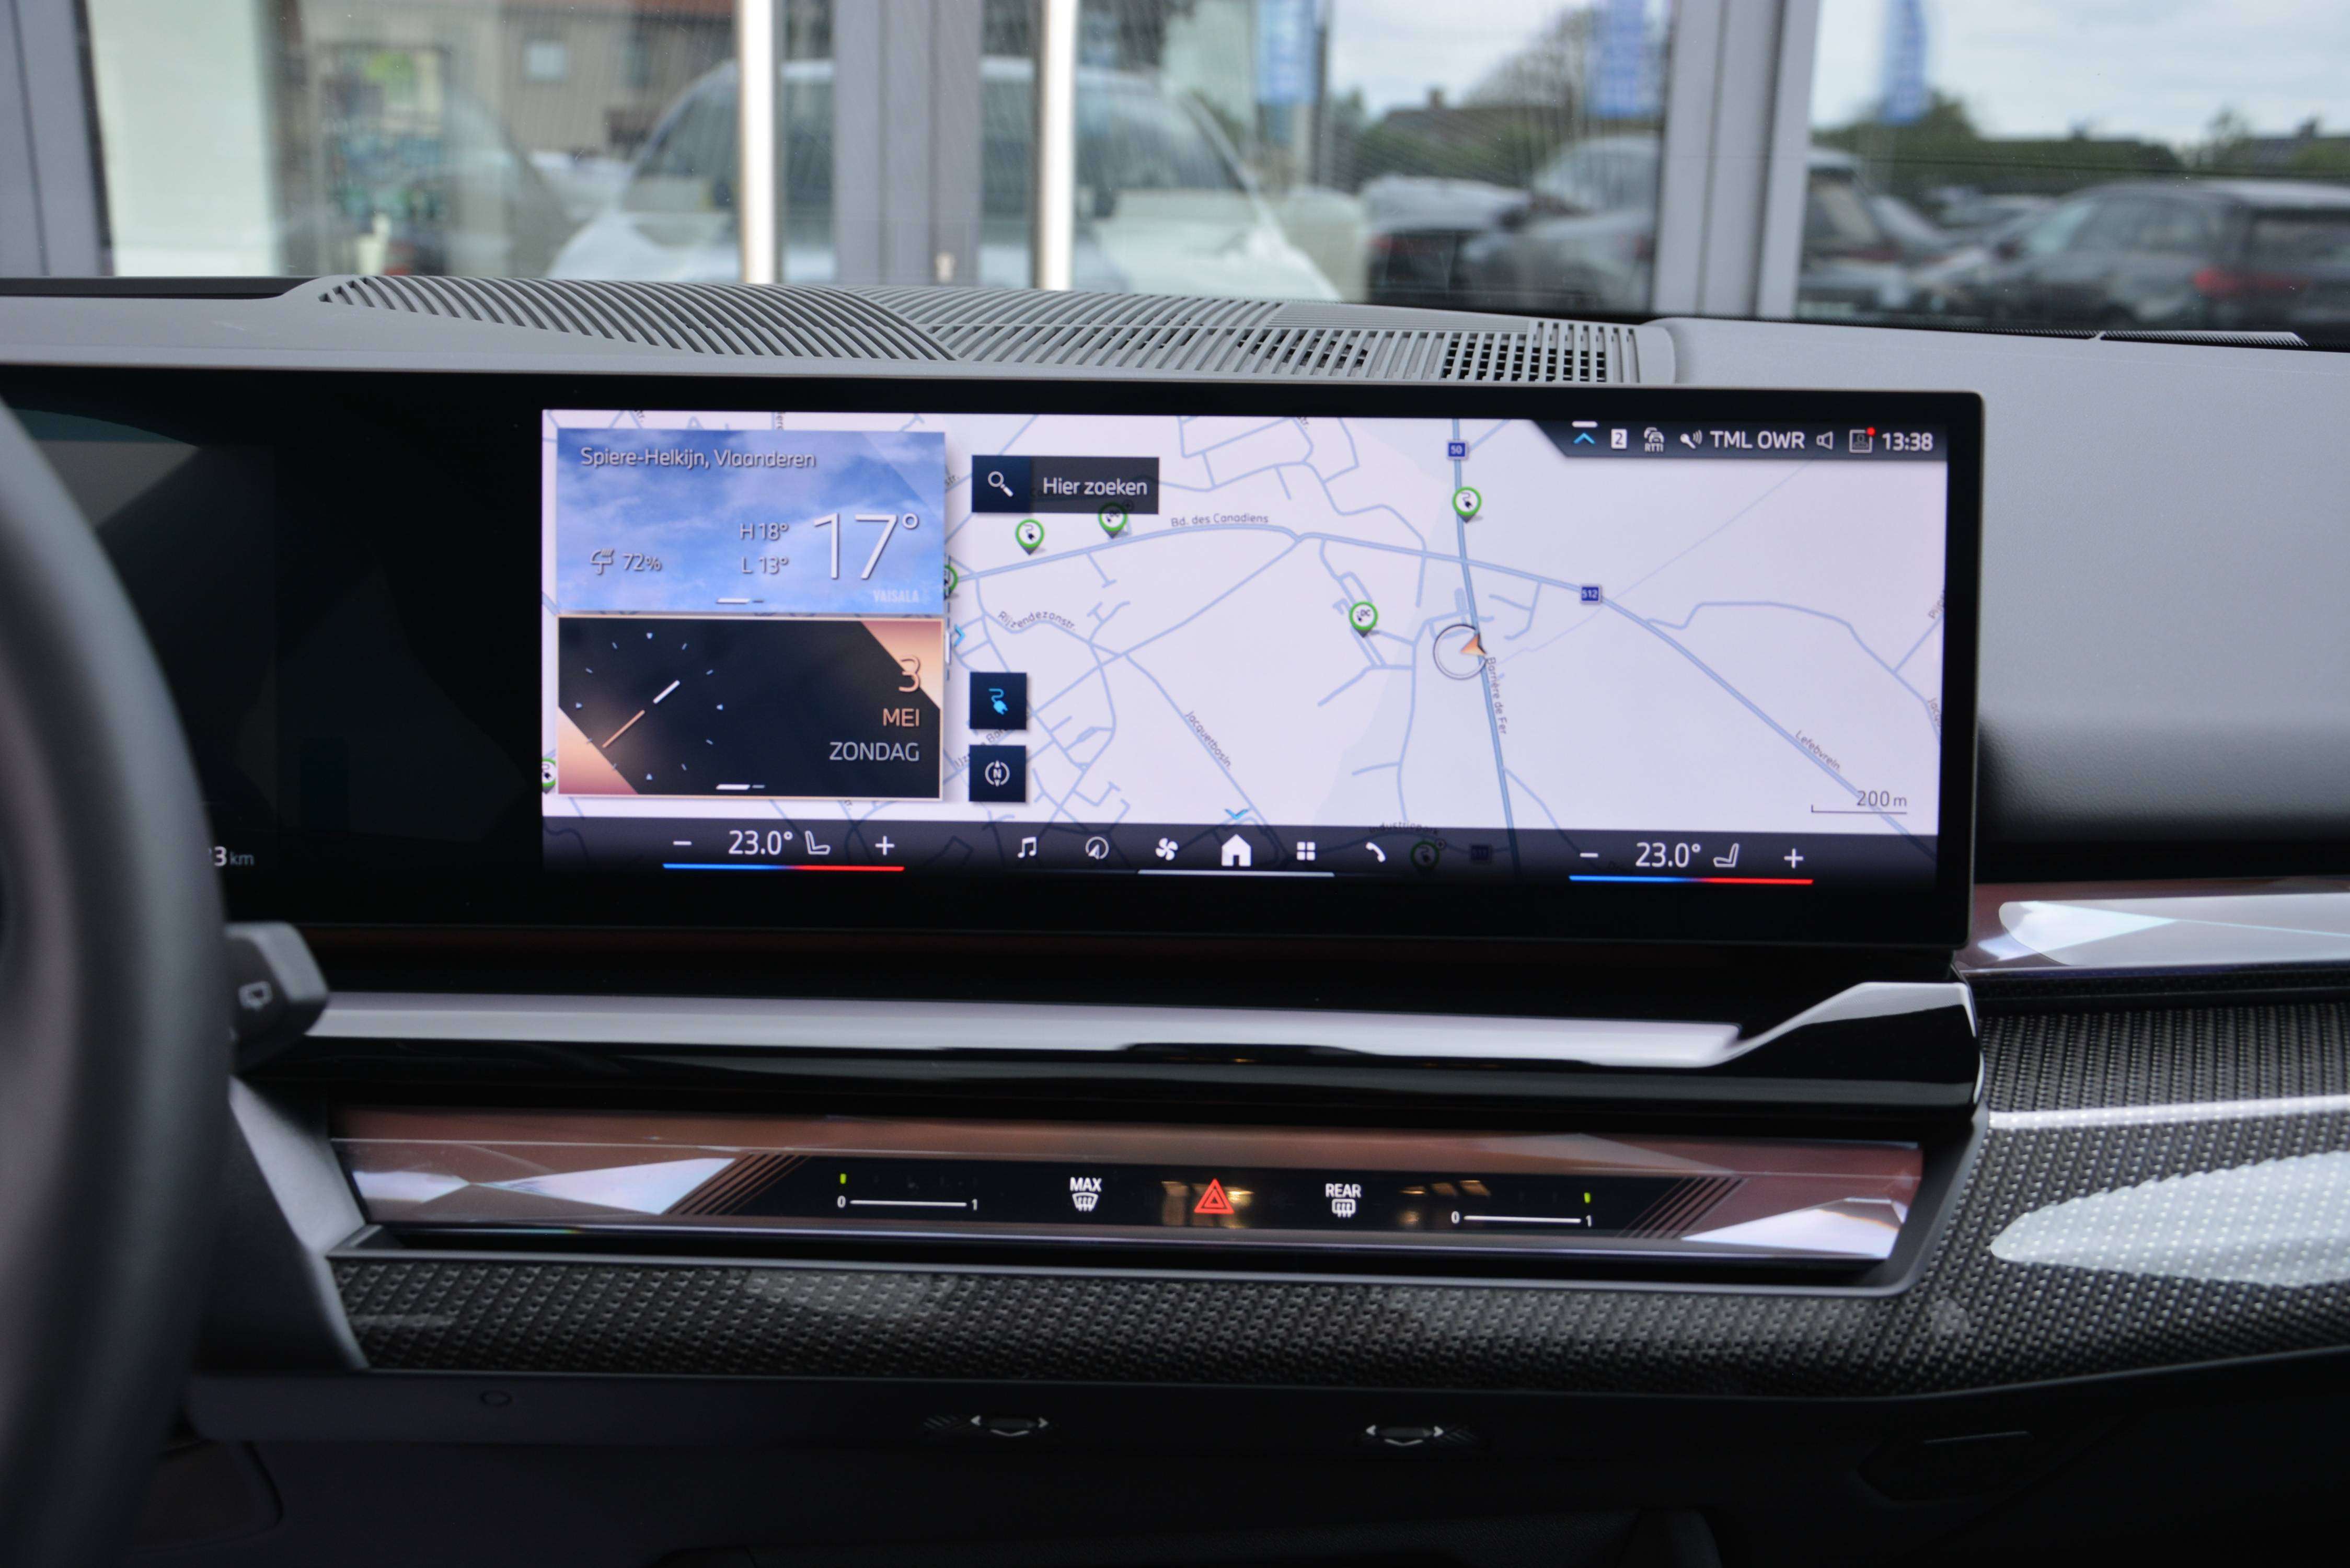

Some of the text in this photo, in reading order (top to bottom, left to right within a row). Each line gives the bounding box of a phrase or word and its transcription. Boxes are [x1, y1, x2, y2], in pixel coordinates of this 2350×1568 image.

[1615, 432, 1623, 445] 2
[1644, 443, 1664, 453] RTTI
[1710, 430, 1805, 449] TML OWR
[1882, 432, 1934, 451] 13:38
[580, 447, 816, 470] Spiere-Helkijn, Vlaanderen
[1043, 477, 1080, 495] Hier
[1083, 477, 1148, 497] zoeken
[1170, 512, 1269, 527] Bd. des Canadiens
[813, 512, 920, 580] 17°
[622, 553, 662, 572] 72%
[872, 591, 919, 603] VAISALA
[898, 654, 921, 693] 3
[883, 708, 921, 728] MEI
[828, 741, 921, 763] ZONDAG
[1856, 790, 1908, 809] 200 m
[728, 829, 794, 856] 23.0°
[208, 845, 255, 867] 3 km
[1634, 842, 1702, 869] 23.0°
[1069, 1177, 1102, 1192] MAX
[1324, 1183, 1362, 1198] REAR
[836, 1194, 978, 1211] 0 1
[1451, 1211, 1593, 1227] 0 1
